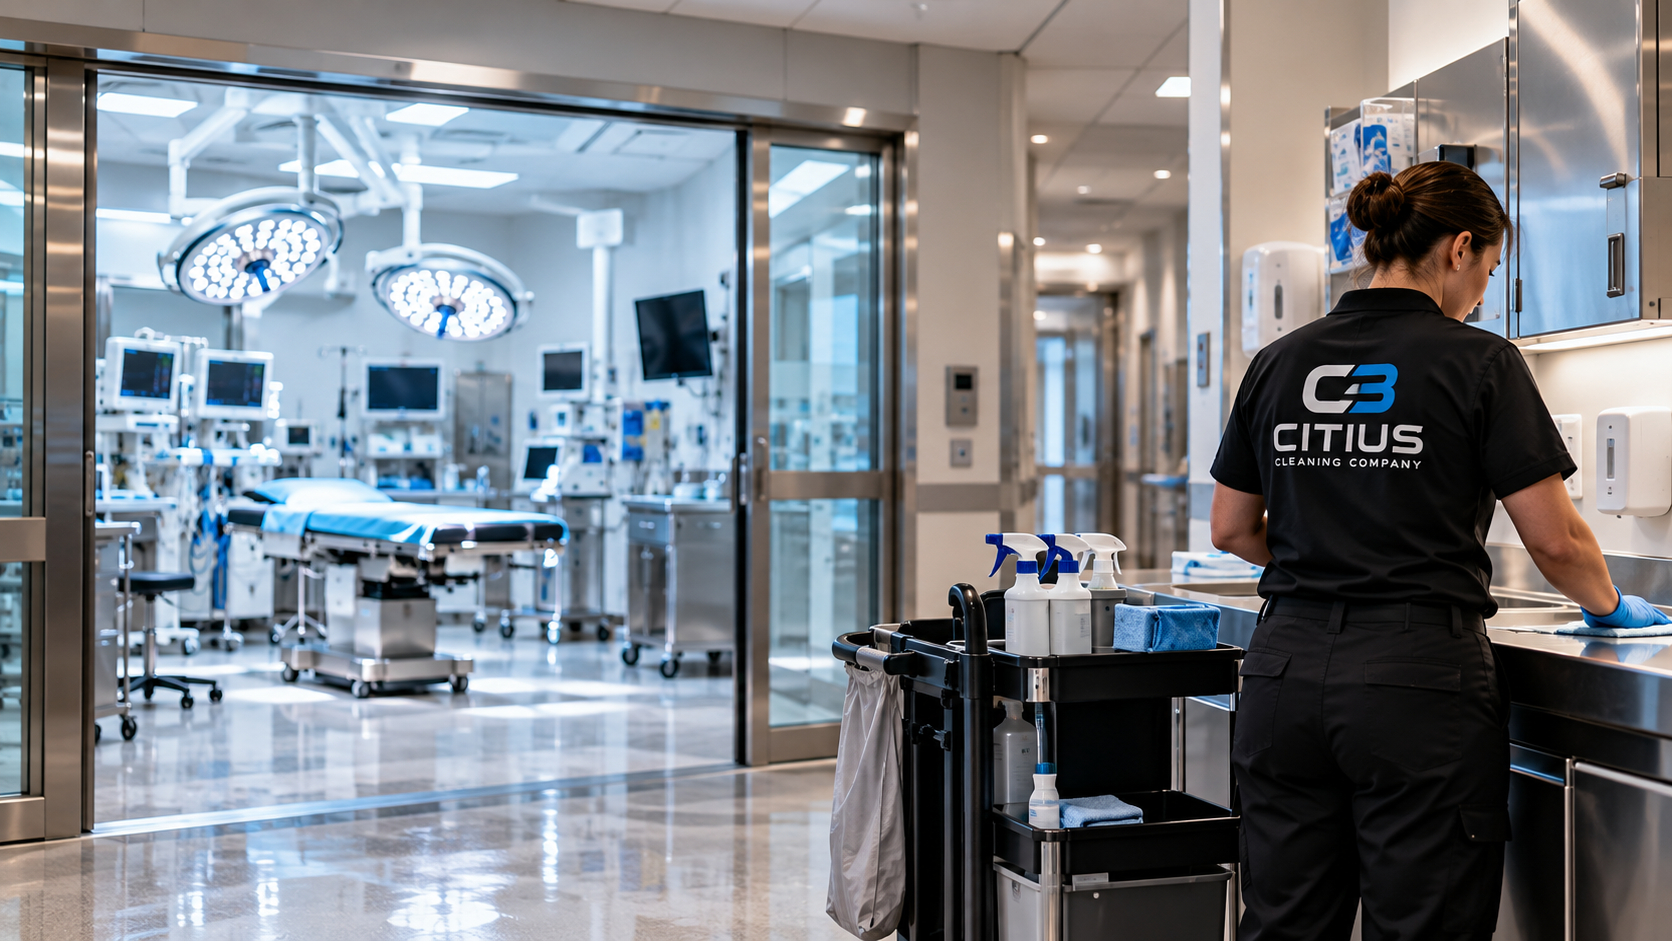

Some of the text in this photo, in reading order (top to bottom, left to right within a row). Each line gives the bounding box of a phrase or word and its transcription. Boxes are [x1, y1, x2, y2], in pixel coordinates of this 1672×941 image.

[1273, 423, 1424, 455] CITIUS
[1274, 456, 1422, 470] CLEANING COMPANY
